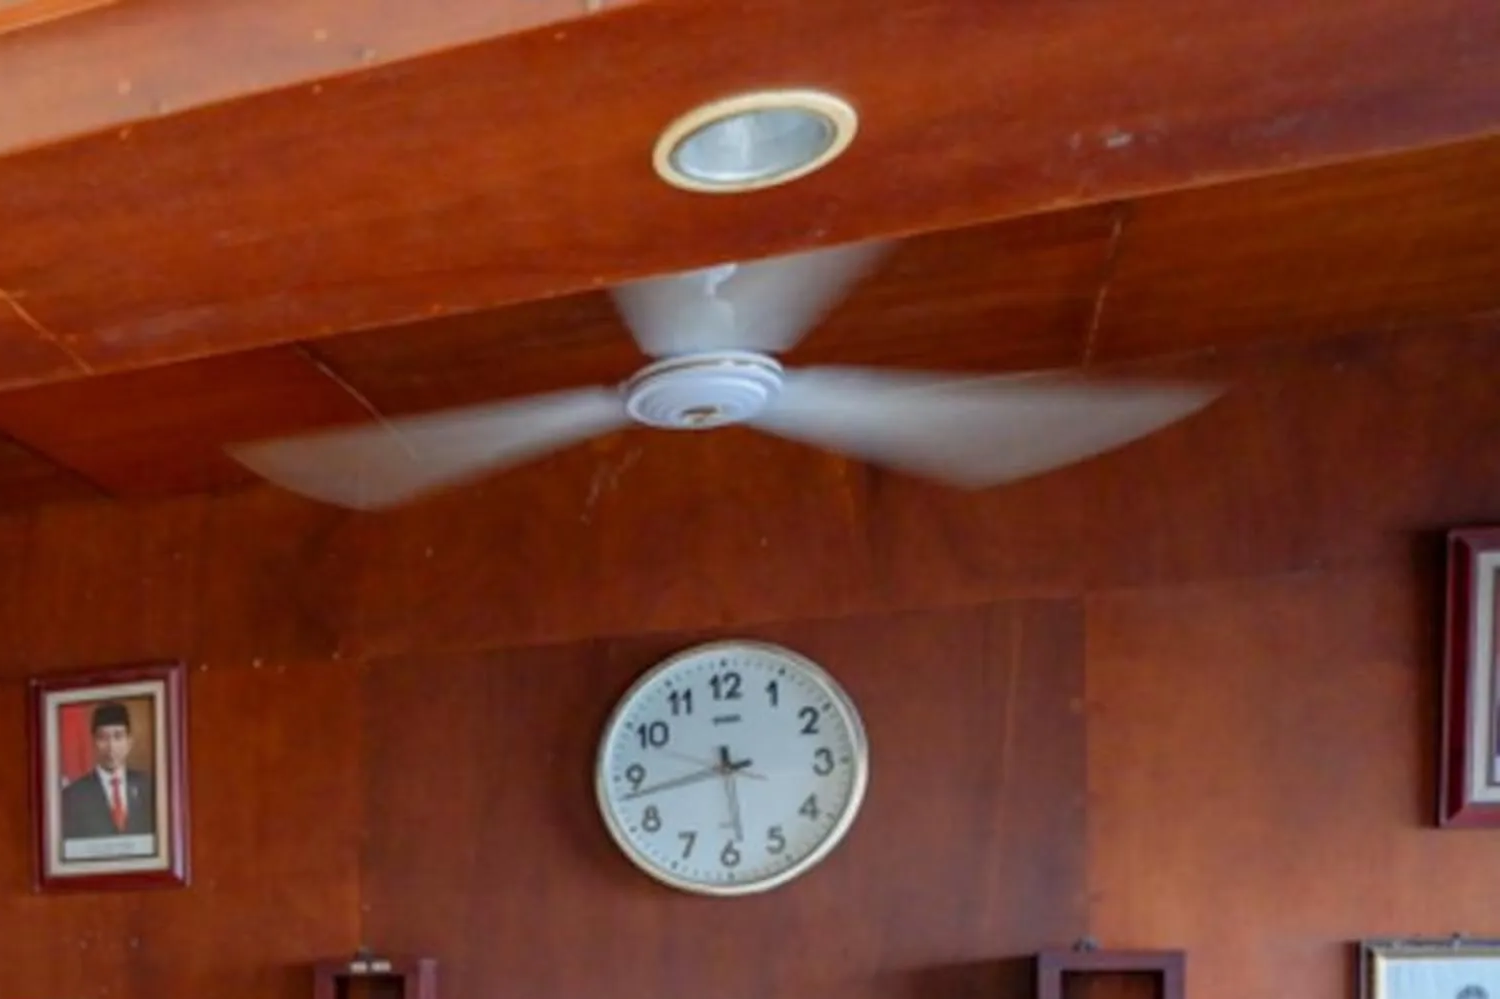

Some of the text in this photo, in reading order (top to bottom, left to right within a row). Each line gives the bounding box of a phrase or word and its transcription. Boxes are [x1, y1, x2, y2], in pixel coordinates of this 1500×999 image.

[709, 671, 743, 700] 12
[765, 680, 778, 707] 1
[668, 689, 693, 716] 11
[798, 706, 820, 735] 2
[637, 721, 670, 750] 10
[812, 747, 835, 776] 3
[625, 763, 646, 792] 9
[641, 805, 661, 833] 8
[798, 792, 819, 821] 4
[678, 831, 698, 860] 7
[720, 839, 740, 868] 6
[765, 825, 786, 855] 5
